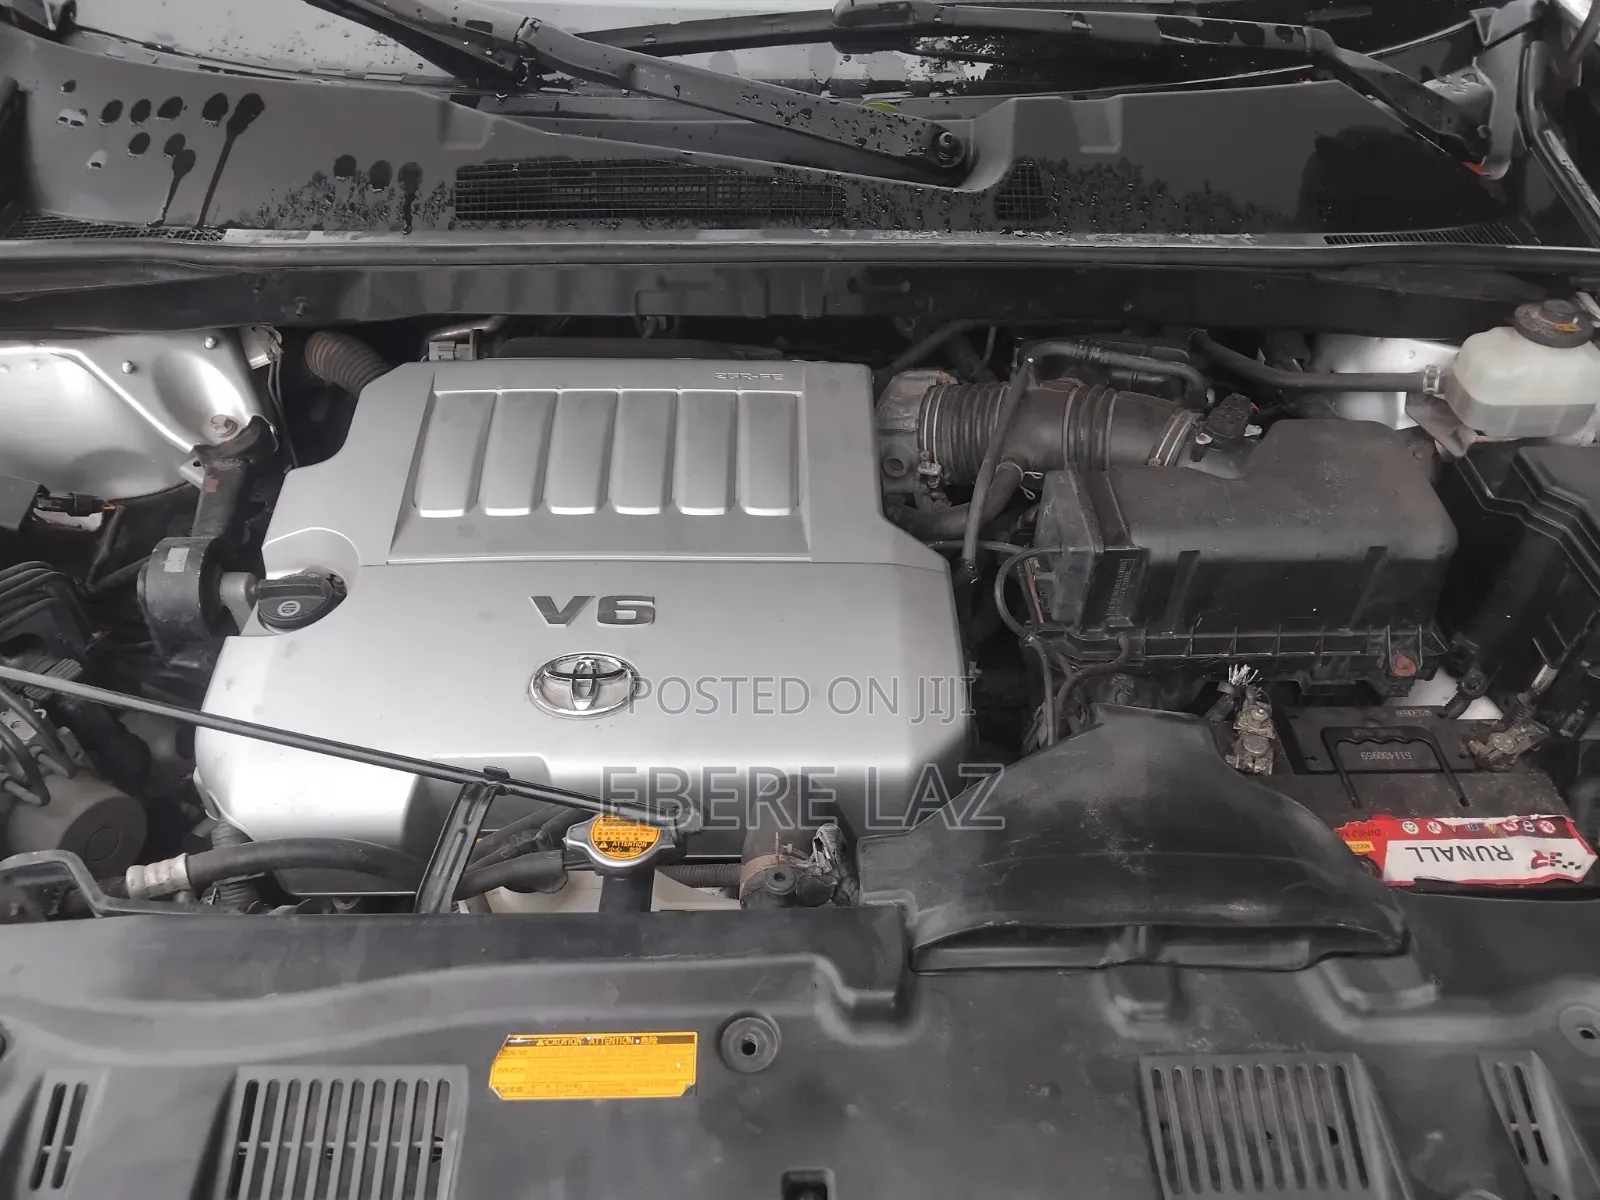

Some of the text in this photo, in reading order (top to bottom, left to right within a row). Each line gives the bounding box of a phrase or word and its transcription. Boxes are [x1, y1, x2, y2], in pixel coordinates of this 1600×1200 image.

[528, 595, 656, 627] V6
[1405, 845, 1514, 863] RUNALL
[547, 1037, 582, 1046] CAUTION
[588, 1036, 634, 1045] ATTENTION
